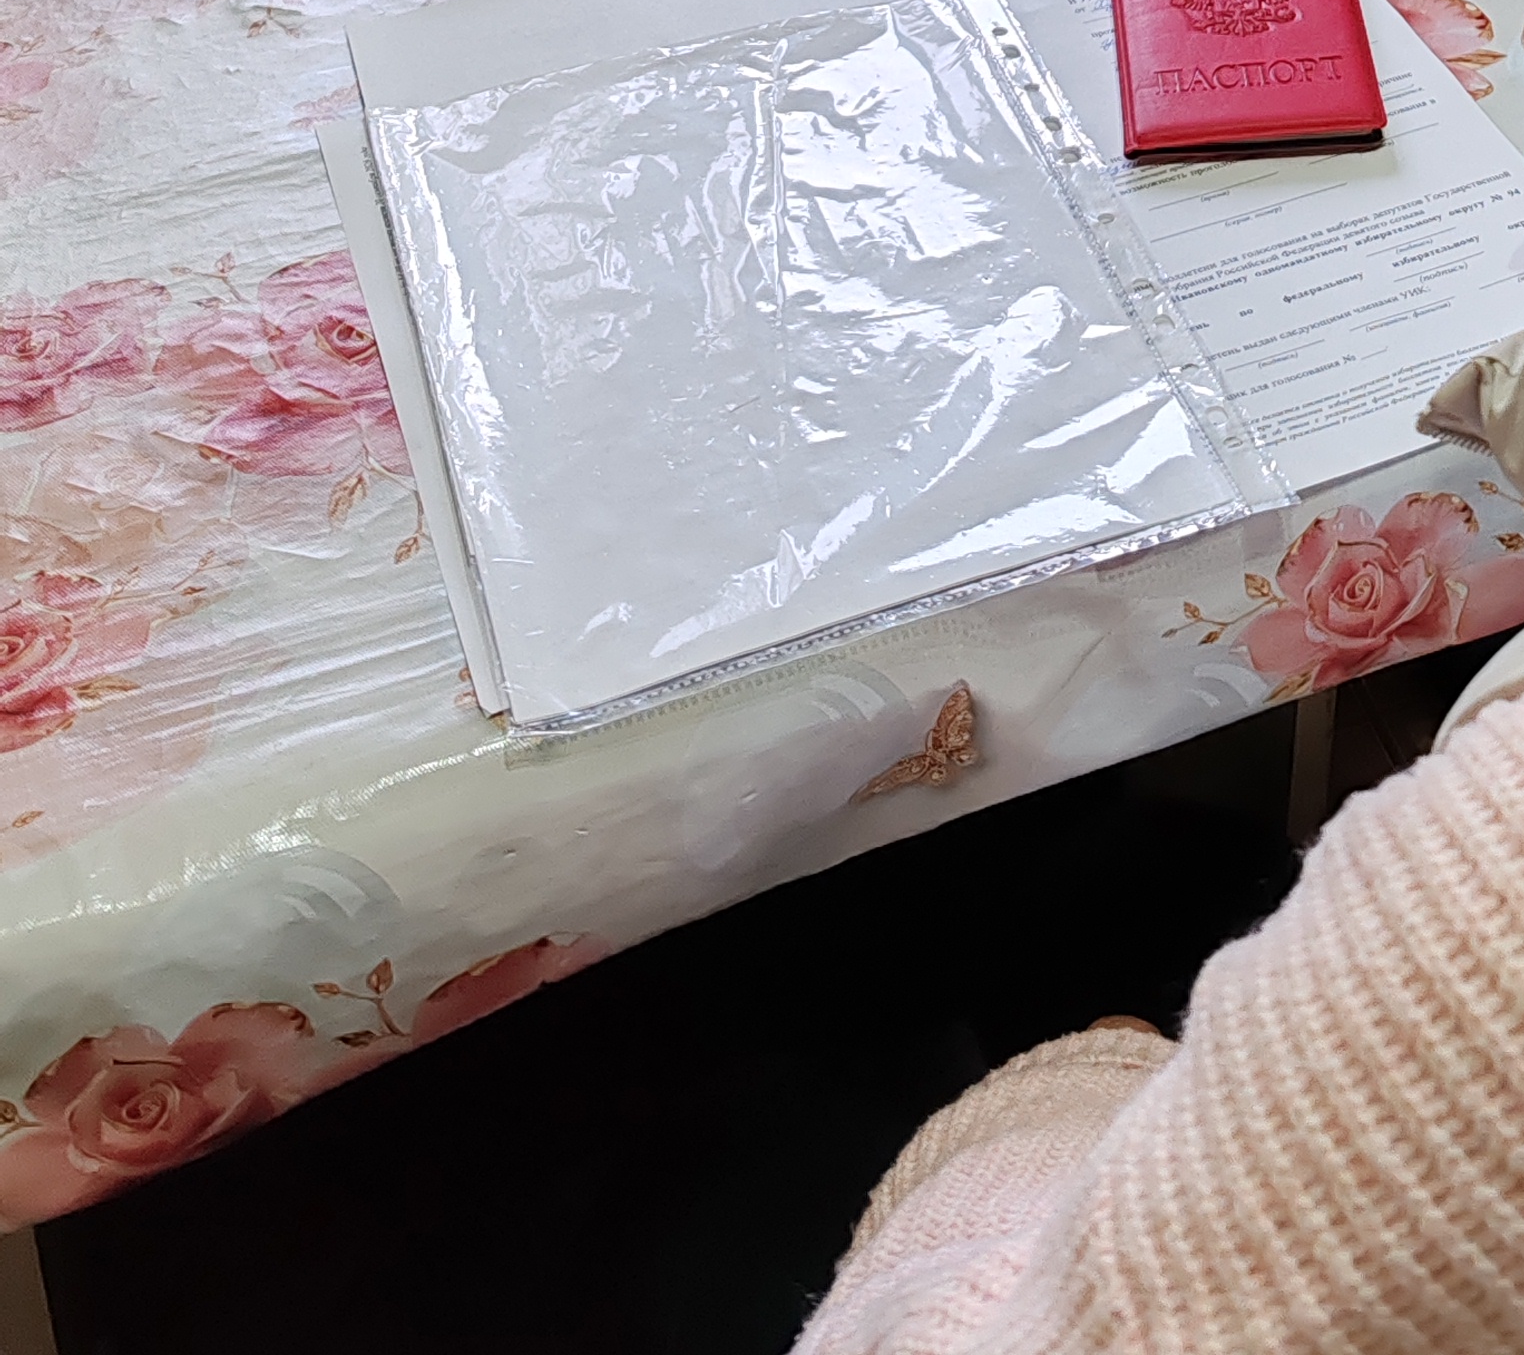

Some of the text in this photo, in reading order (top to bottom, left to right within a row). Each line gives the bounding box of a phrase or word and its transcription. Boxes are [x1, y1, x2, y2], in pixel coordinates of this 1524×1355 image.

[1154, 55, 1344, 96] ПАСПОРТ
[1379, 71, 1413, 88] ричине
[1387, 100, 1428, 117] сования
[1217, 253, 1280, 279] Российской
[1281, 234, 1343, 259] Федерации
[1342, 220, 1388, 241] девятого
[1389, 208, 1425, 226] созыва
[1219, 255, 1240, 269] для
[1241, 234, 1308, 260] голосования
[1310, 230, 1324, 239] на
[1326, 213, 1371, 234] выборах
[1373, 198, 1424, 221] депутатов
[1424, 170, 1512, 205] Государственной
[1254, 243, 1349, 279] одномандатному
[1354, 213, 1443, 247] избирательному
[1448, 199, 1486, 219] округу
[1490, 193, 1504, 205] №
[1507, 187, 1522, 198] 94
[1239, 307, 1254, 318] по
[1282, 271, 1365, 305] федеральному
[1392, 234, 1481, 268] избирательному
[1419, 261, 1469, 284] (подпись)
[1243, 334, 1278, 352] выдан
[1279, 310, 1353, 340] следующими
[1353, 294, 1400, 314] членами
[1399, 285, 1432, 302] УИК:
[1250, 382, 1270, 398] для
[1271, 359, 1341, 388] голосования
